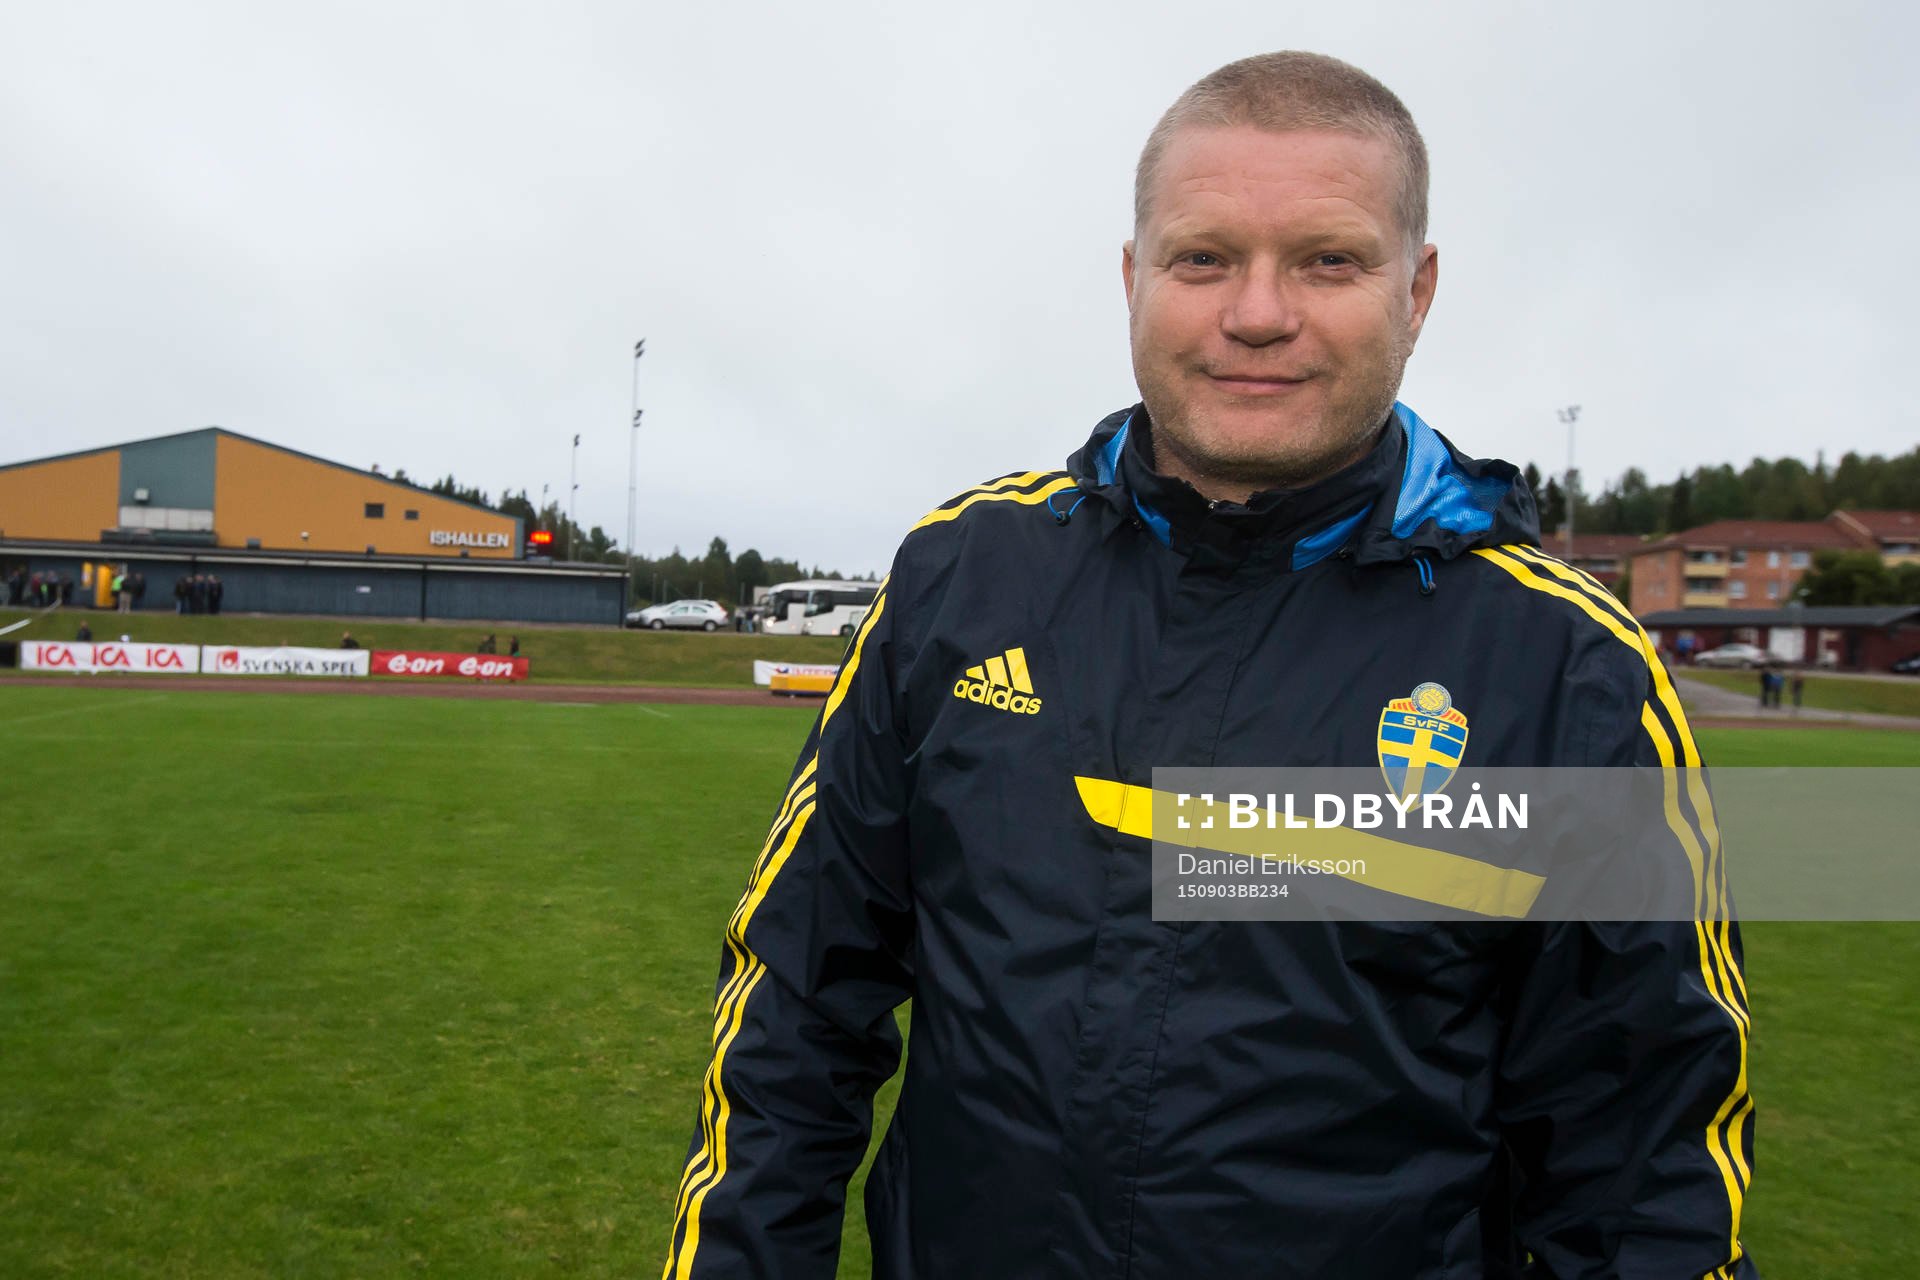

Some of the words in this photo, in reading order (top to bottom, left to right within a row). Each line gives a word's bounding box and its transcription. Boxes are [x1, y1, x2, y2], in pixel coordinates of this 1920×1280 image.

[429, 530, 509, 548] ISHALLEN
[36, 645, 76, 666] ICA
[91, 645, 130, 666] ICA
[146, 647, 183, 668] ICA
[242, 658, 314, 673] SVENSKA
[322, 660, 356, 674] SPEL
[953, 679, 1042, 715] adidas
[1403, 715, 1450, 732] SvFF
